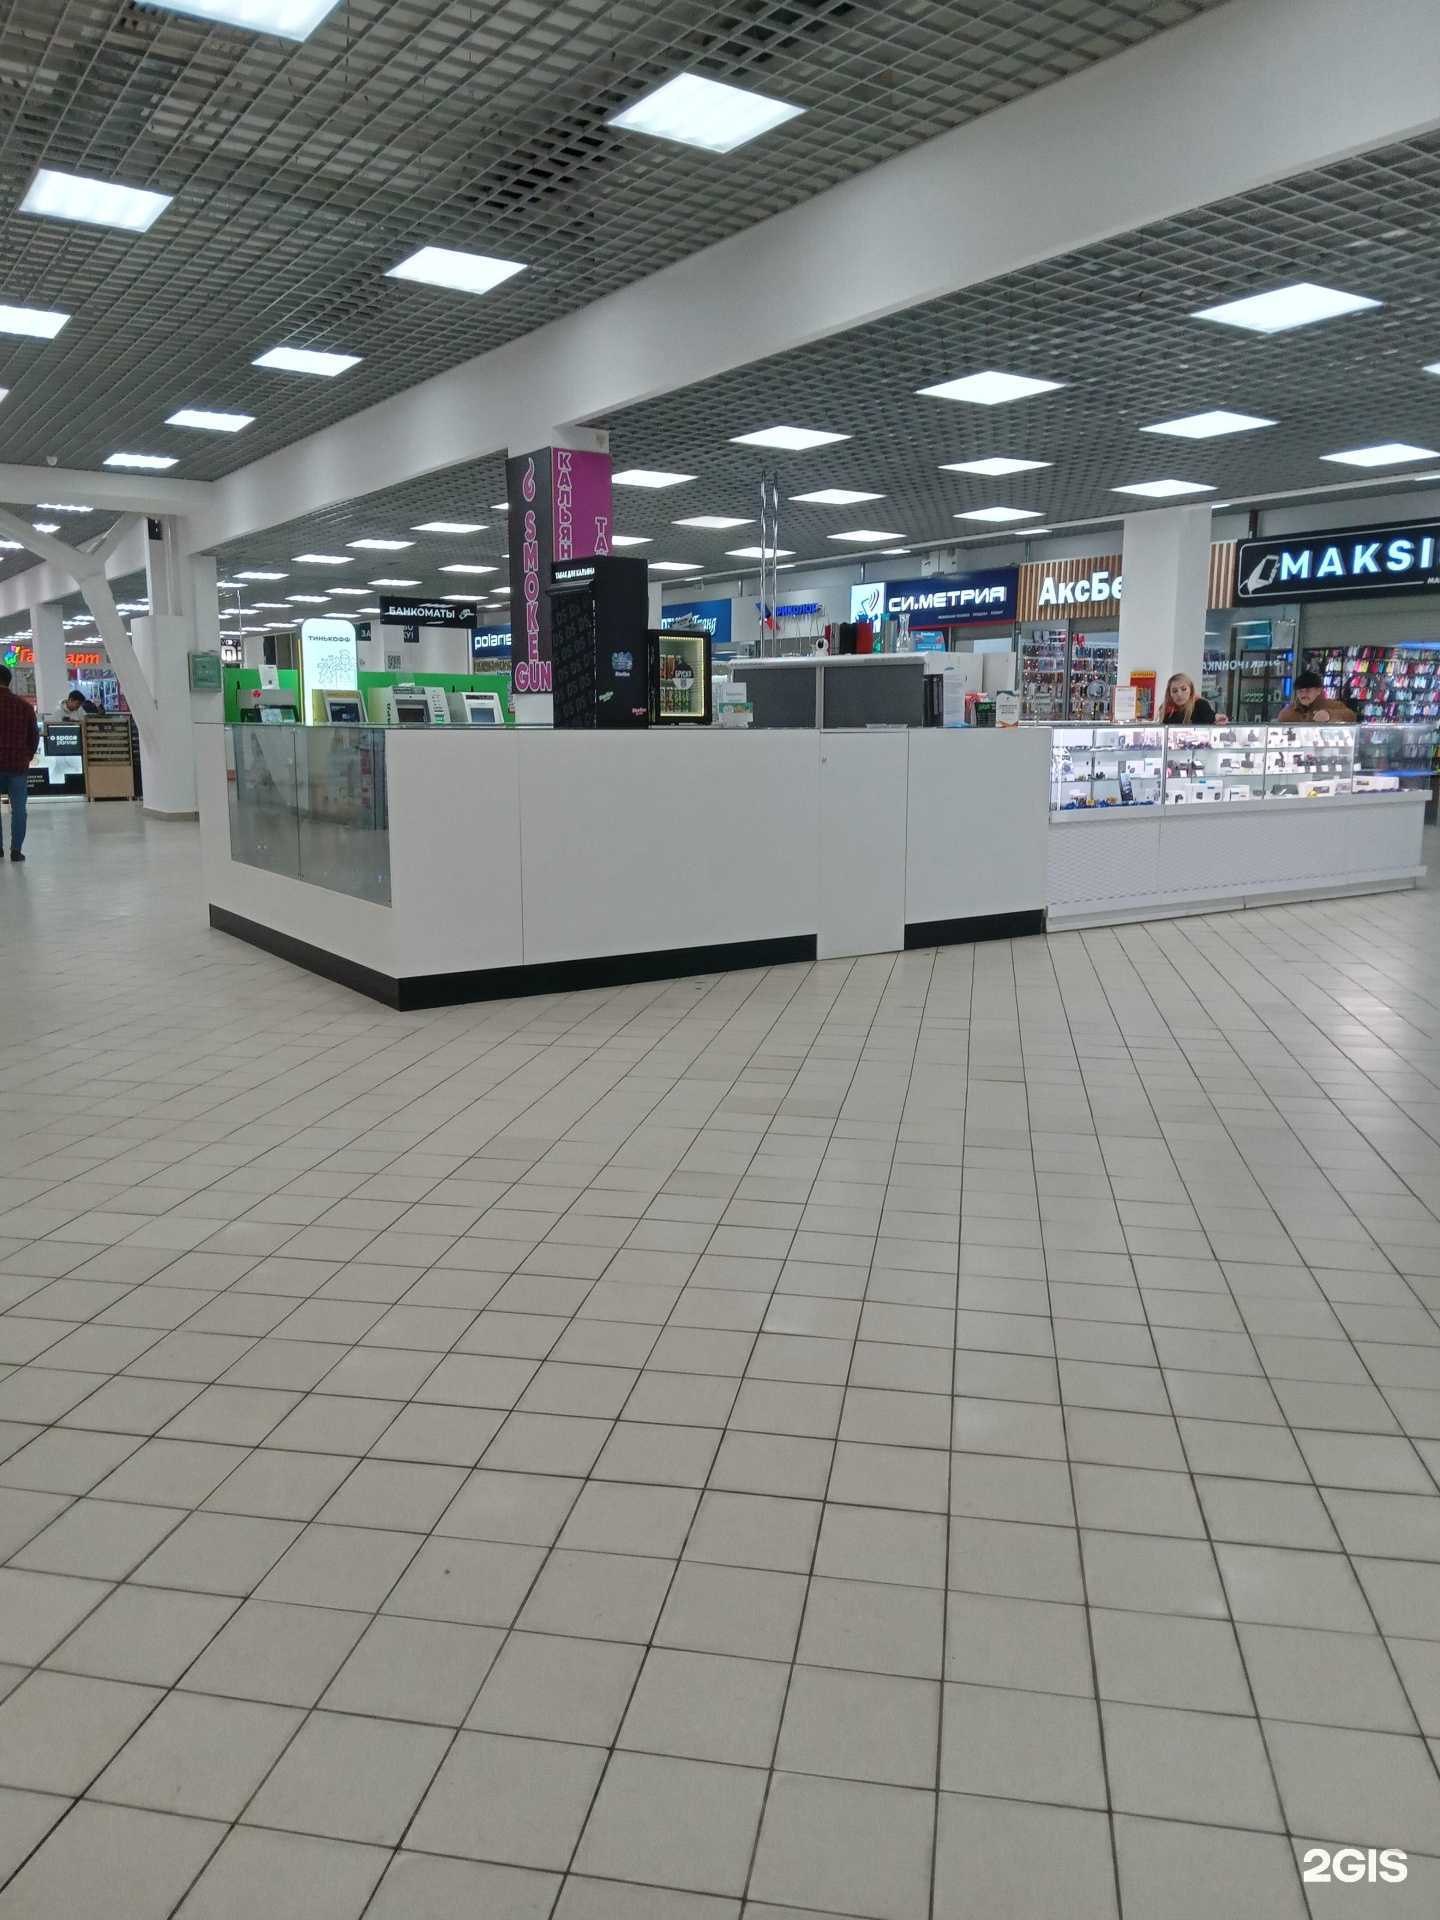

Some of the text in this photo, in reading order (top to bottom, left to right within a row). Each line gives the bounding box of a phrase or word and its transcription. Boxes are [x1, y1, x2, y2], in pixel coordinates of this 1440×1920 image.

[594, 516, 609, 556] ТА
[1280, 537, 1435, 581] MAKSI
[523, 510, 539, 661] SMOKE
[888, 586, 1007, 612] СИ.МЕТРИЯ
[388, 606, 456, 619] БАНКОМАТЫ
[308, 635, 351, 643] ТИНЬКОФФ
[474, 633, 512, 650] polaris
[515, 661, 552, 692] GUN
